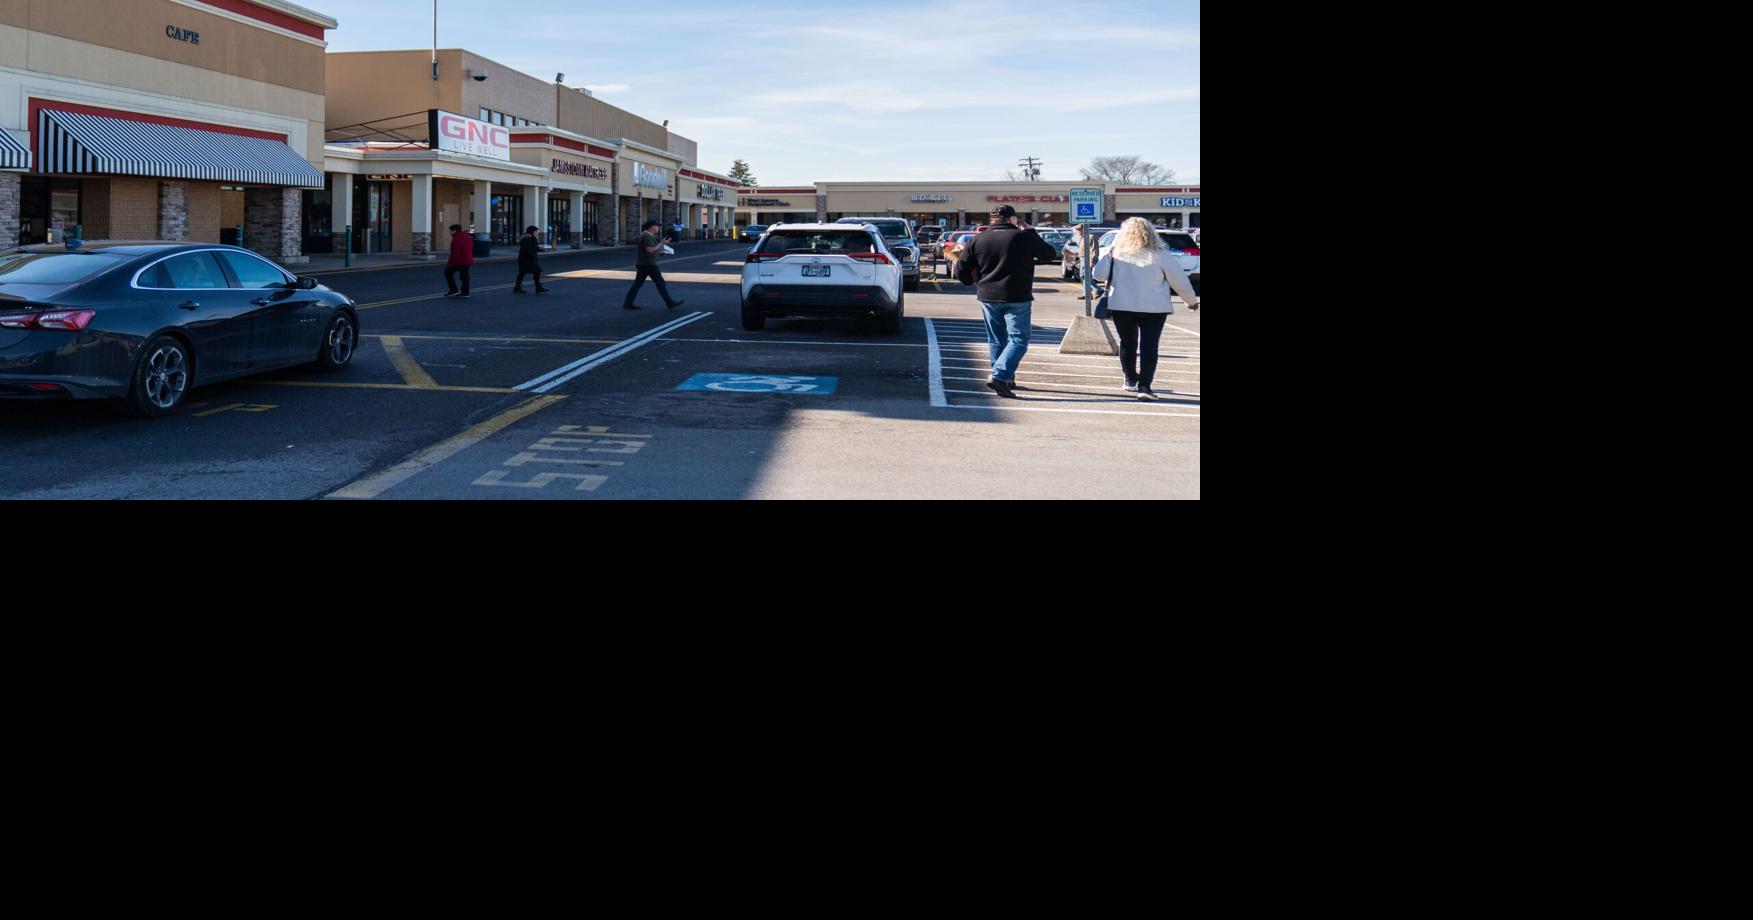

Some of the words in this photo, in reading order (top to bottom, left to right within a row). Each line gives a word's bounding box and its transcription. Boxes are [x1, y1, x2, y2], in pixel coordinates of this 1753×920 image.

[165, 24, 200, 45] CAFE
[441, 115, 508, 149] GNC
[454, 140, 473, 152] LIVE
[477, 143, 497, 157] WELL
[471, 424, 656, 491] STOP
